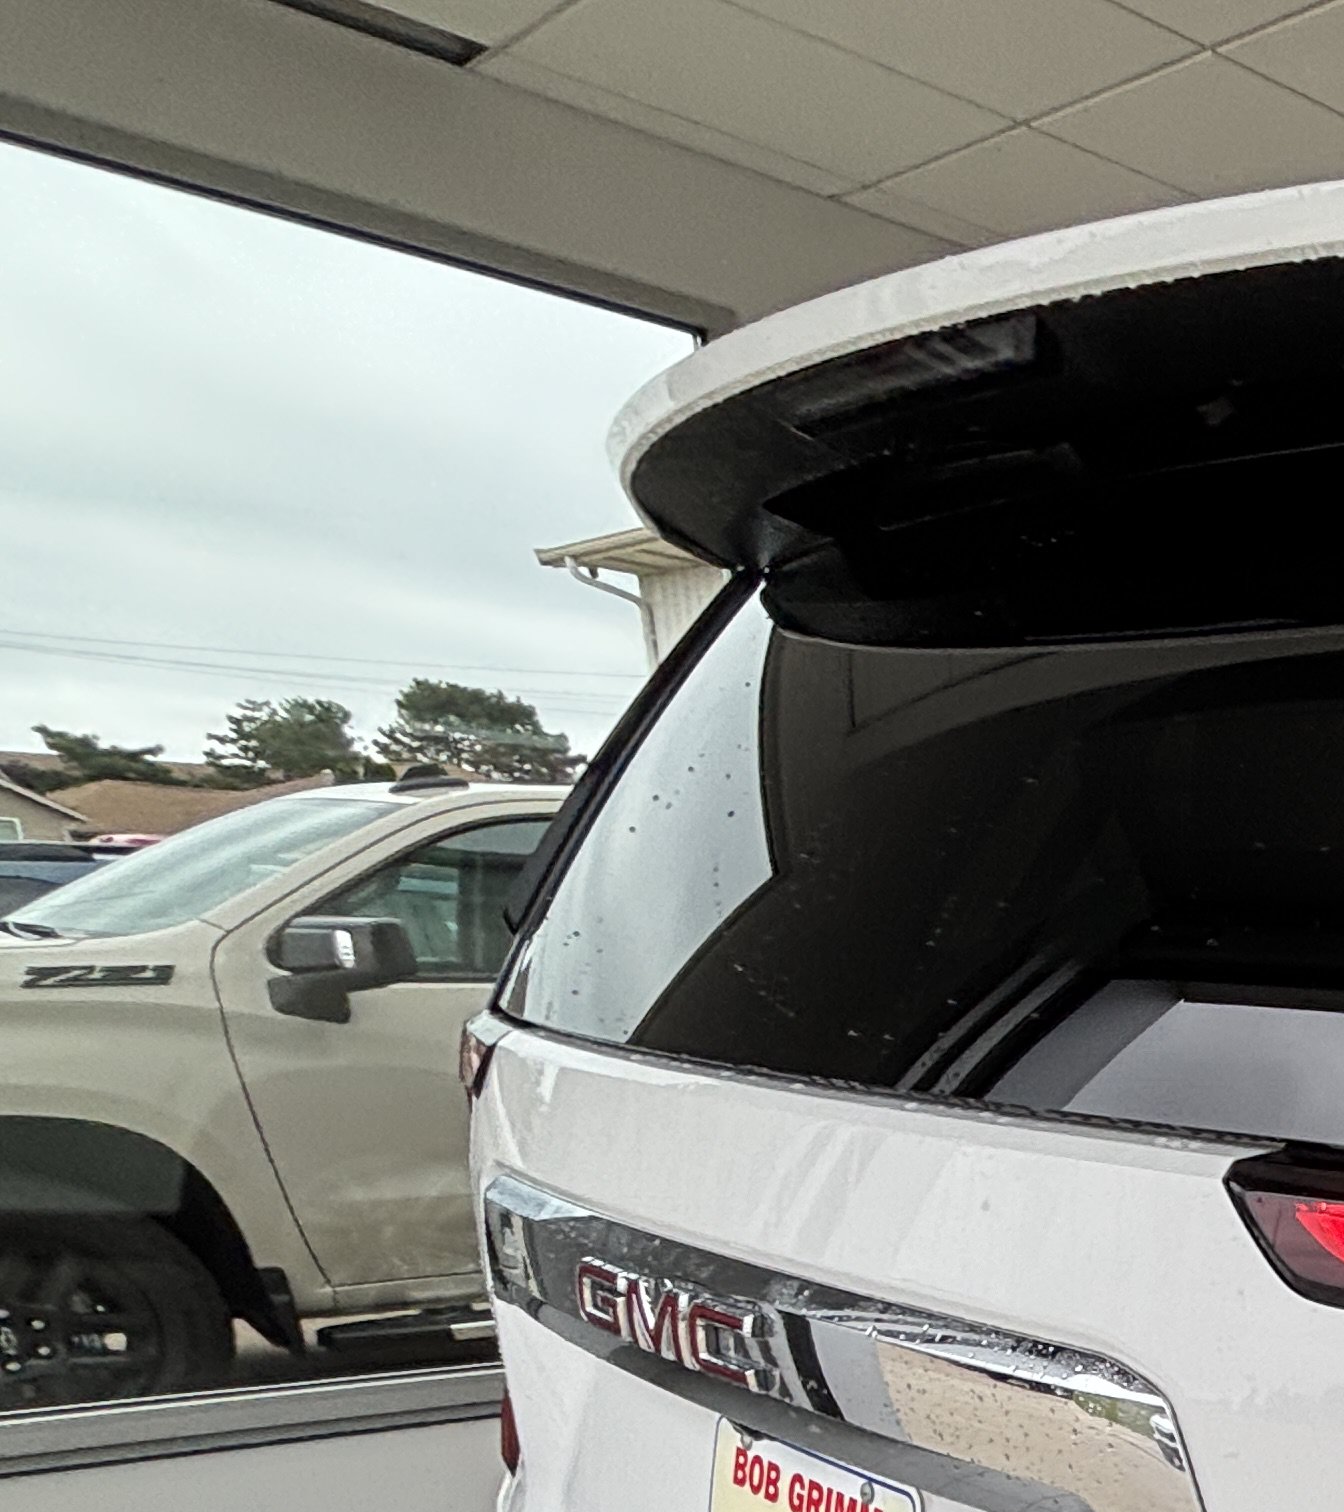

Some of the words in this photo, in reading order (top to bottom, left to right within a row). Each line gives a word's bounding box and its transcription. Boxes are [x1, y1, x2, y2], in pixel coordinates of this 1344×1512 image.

[20, 964, 176, 989] Z71
[577, 1256, 770, 1394] GMC
[733, 1446, 781, 1503] BOB
